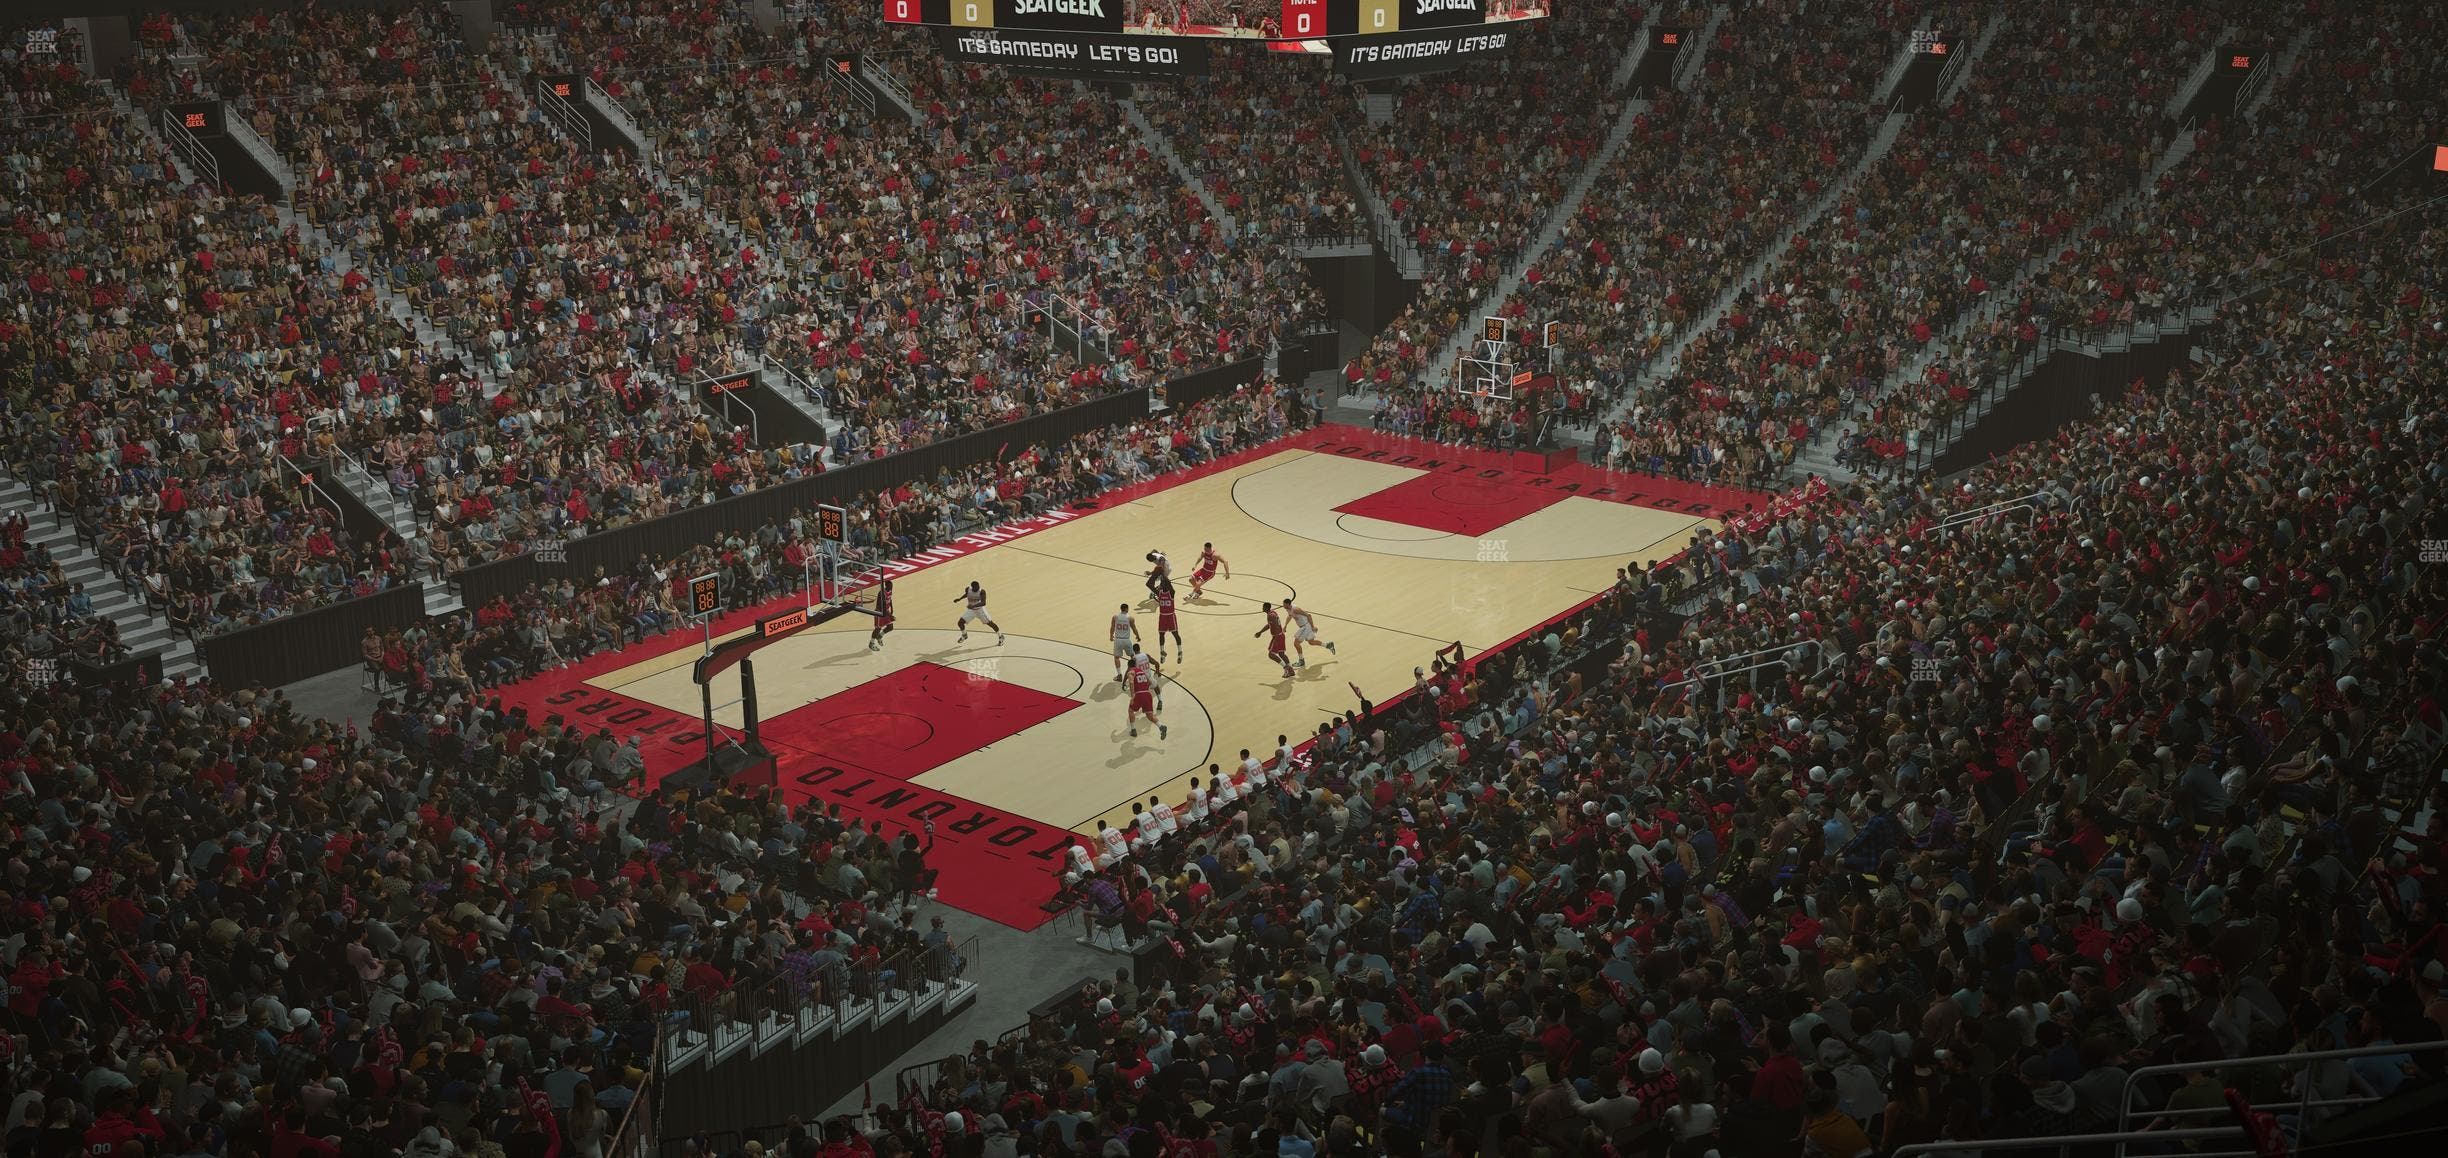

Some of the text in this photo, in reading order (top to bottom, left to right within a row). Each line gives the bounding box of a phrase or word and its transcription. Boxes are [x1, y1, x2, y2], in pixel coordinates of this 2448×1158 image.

[897, 0, 908, 18] 0
[966, 3, 977, 22] 0
[1374, 8, 1384, 28] 0
[1298, 13, 1310, 33] 0
[958, 37, 987, 54] IT'S
[990, 39, 1078, 59] GAMEDAY
[1089, 44, 1140, 62] LET'S
[1145, 47, 1179, 64] GO!
[1350, 33, 1507, 63] IT'S GAMEDAY LET'S GO!
[186, 113, 204, 121] SEAT
[1313, 441, 1504, 479] TORONTO
[824, 521, 839, 538] 88
[698, 592, 714, 611] 88
[769, 615, 803, 633] SEATGEEK
[796, 766, 1078, 860] TORONTO
